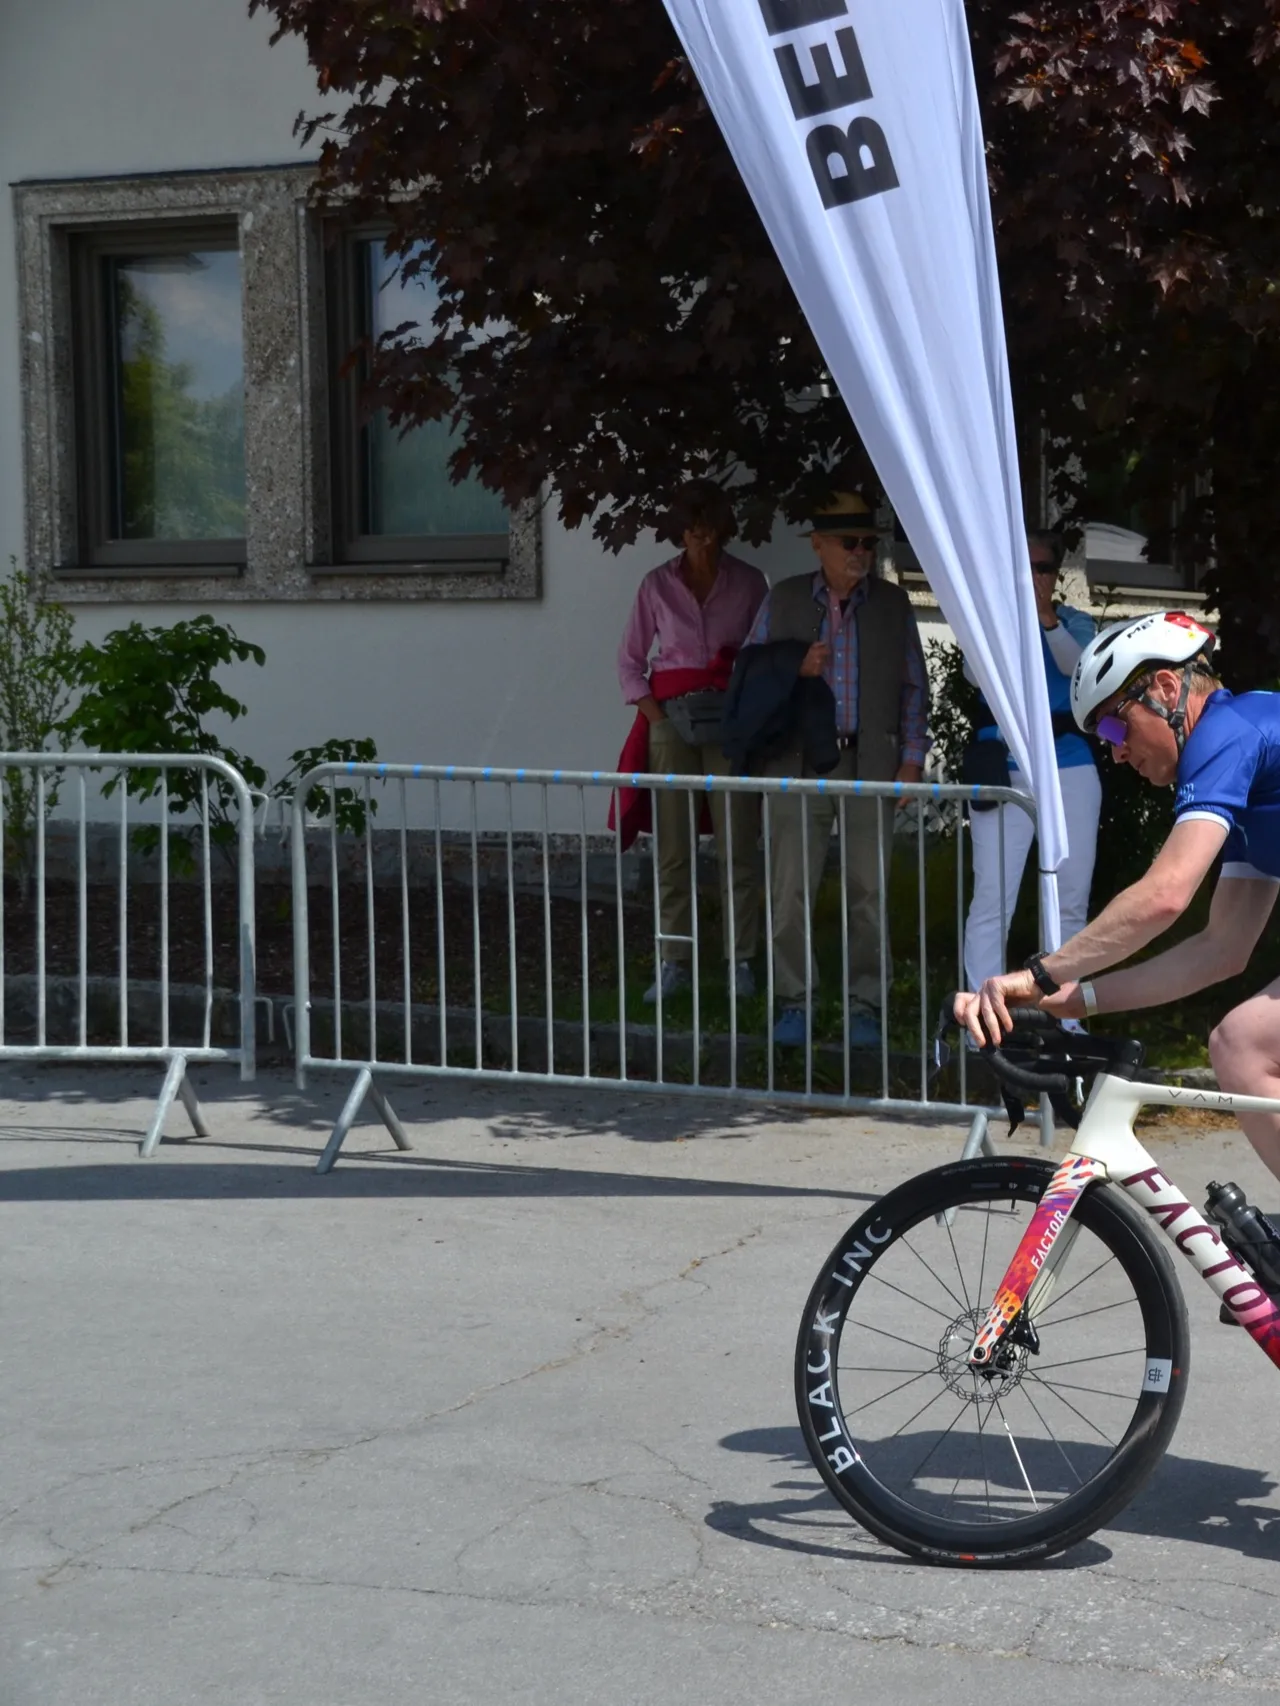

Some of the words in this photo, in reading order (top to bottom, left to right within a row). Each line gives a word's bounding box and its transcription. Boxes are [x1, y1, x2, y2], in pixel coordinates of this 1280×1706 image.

[1030, 1210, 1066, 1270] FACTOR
[806, 1296, 855, 1475] BLACK
[832, 1217, 893, 1288] INC
